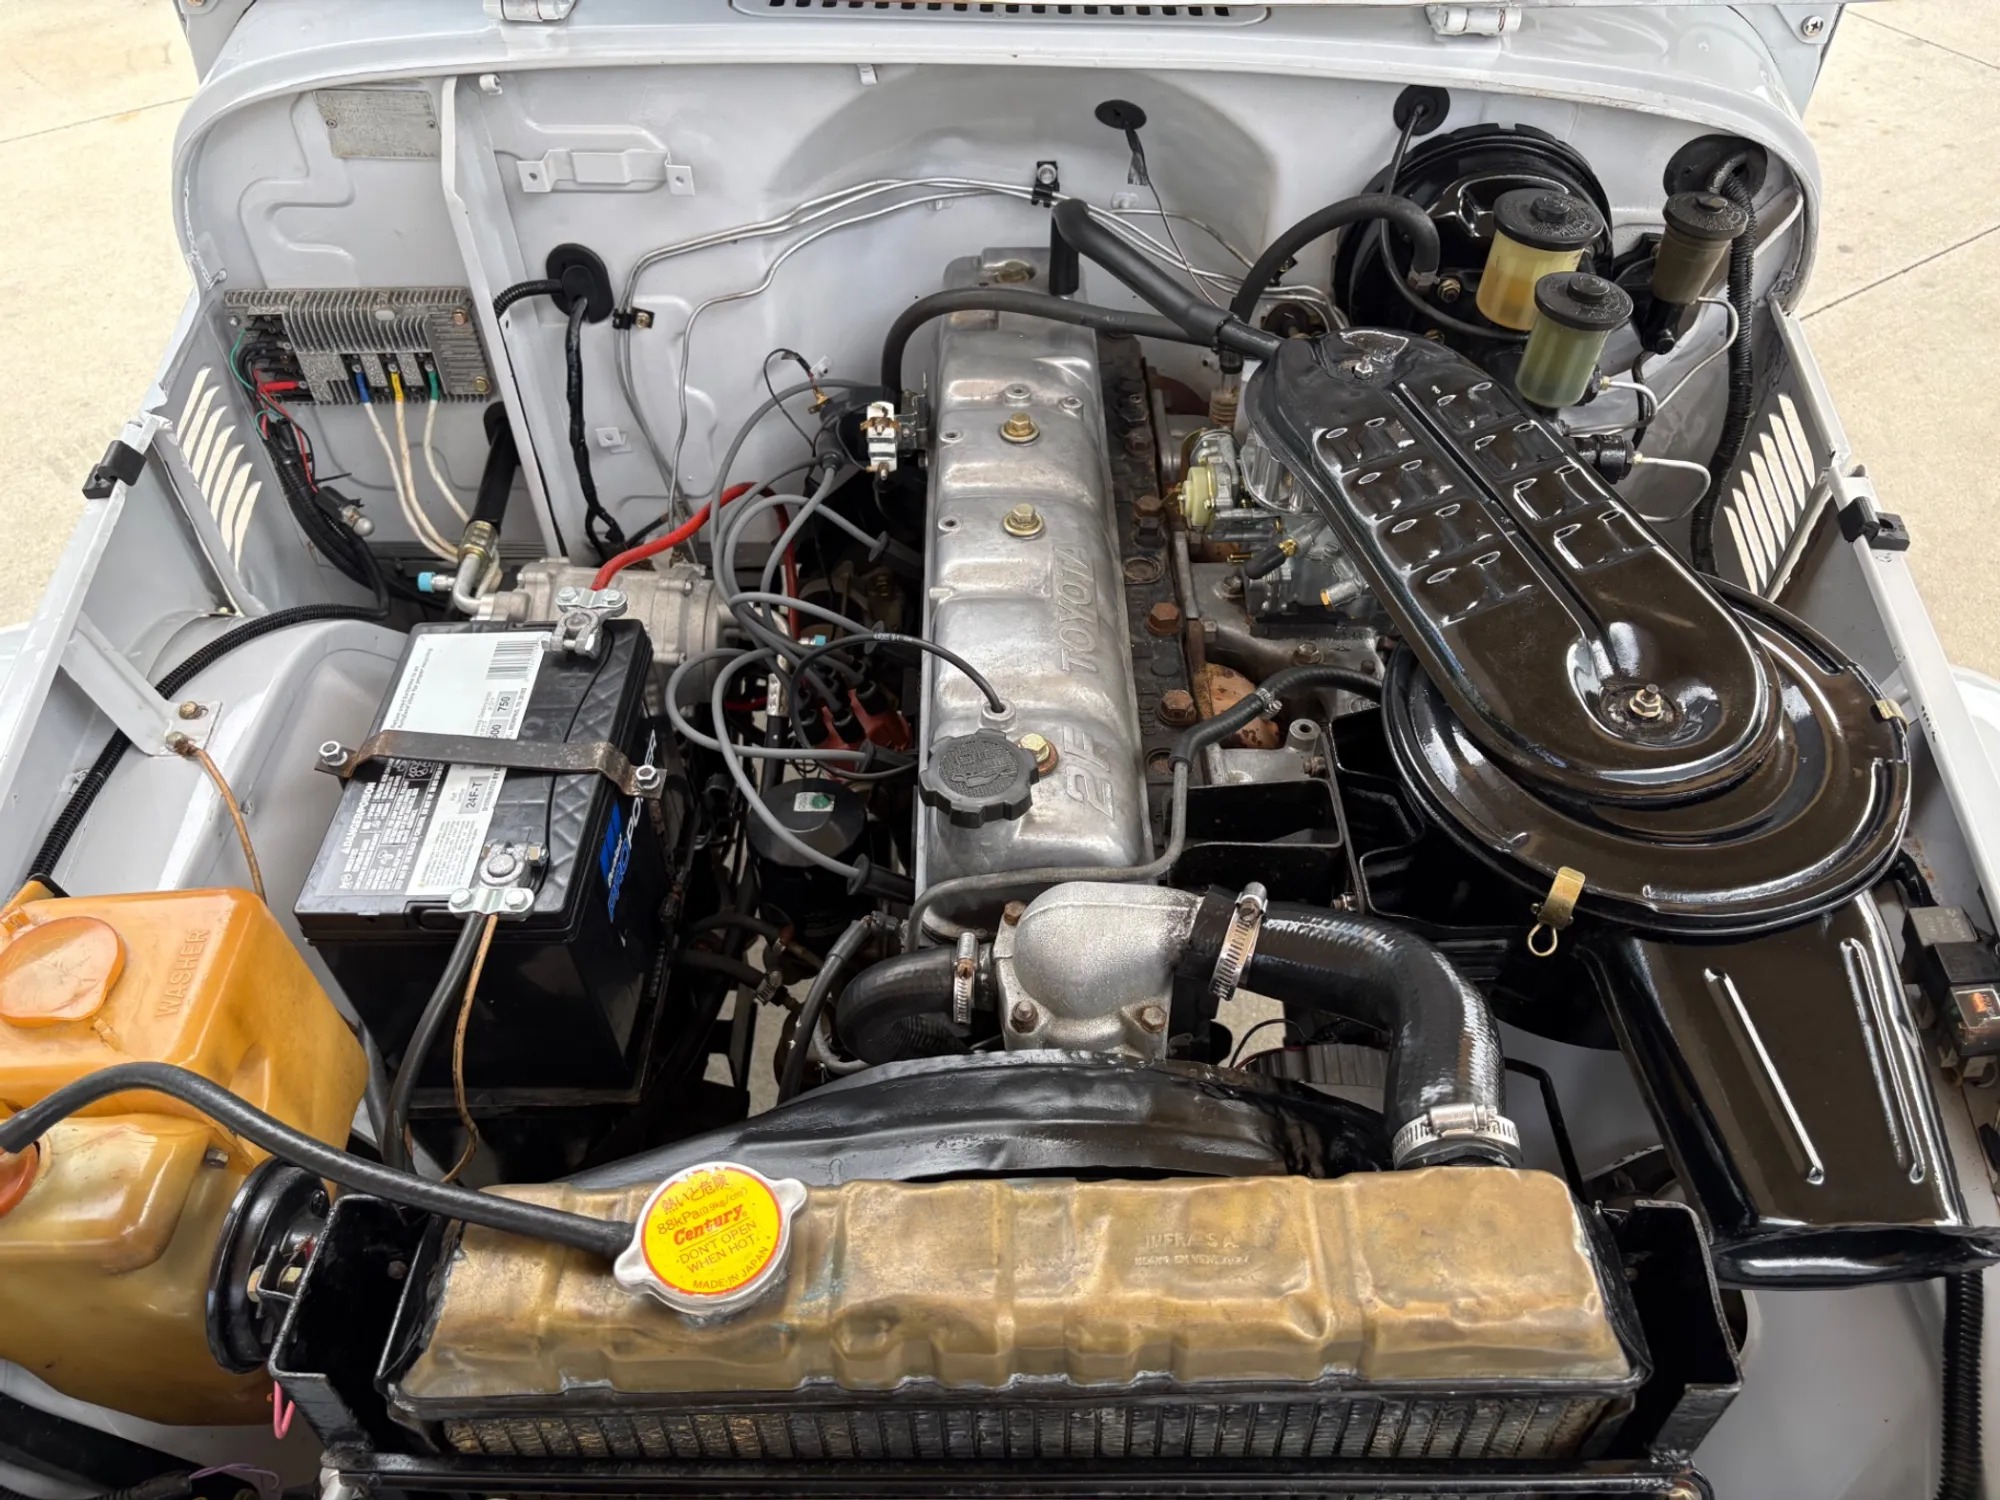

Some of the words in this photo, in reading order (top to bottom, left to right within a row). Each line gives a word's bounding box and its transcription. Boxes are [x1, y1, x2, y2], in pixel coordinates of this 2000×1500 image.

[1053, 545, 1099, 673] TOYOTA
[496, 696, 512, 711] 750
[463, 781, 484, 808] 24F-T
[1062, 725, 1115, 820] 2F
[154, 928, 210, 1018] WASHER
[674, 1203, 744, 1246] Century
[679, 1237, 721, 1265] DON'T
[720, 1220, 758, 1245] OPEN
[687, 1248, 726, 1274] WHEN
[692, 1272, 725, 1290] MADE
[741, 1246, 770, 1280] JAPAN
